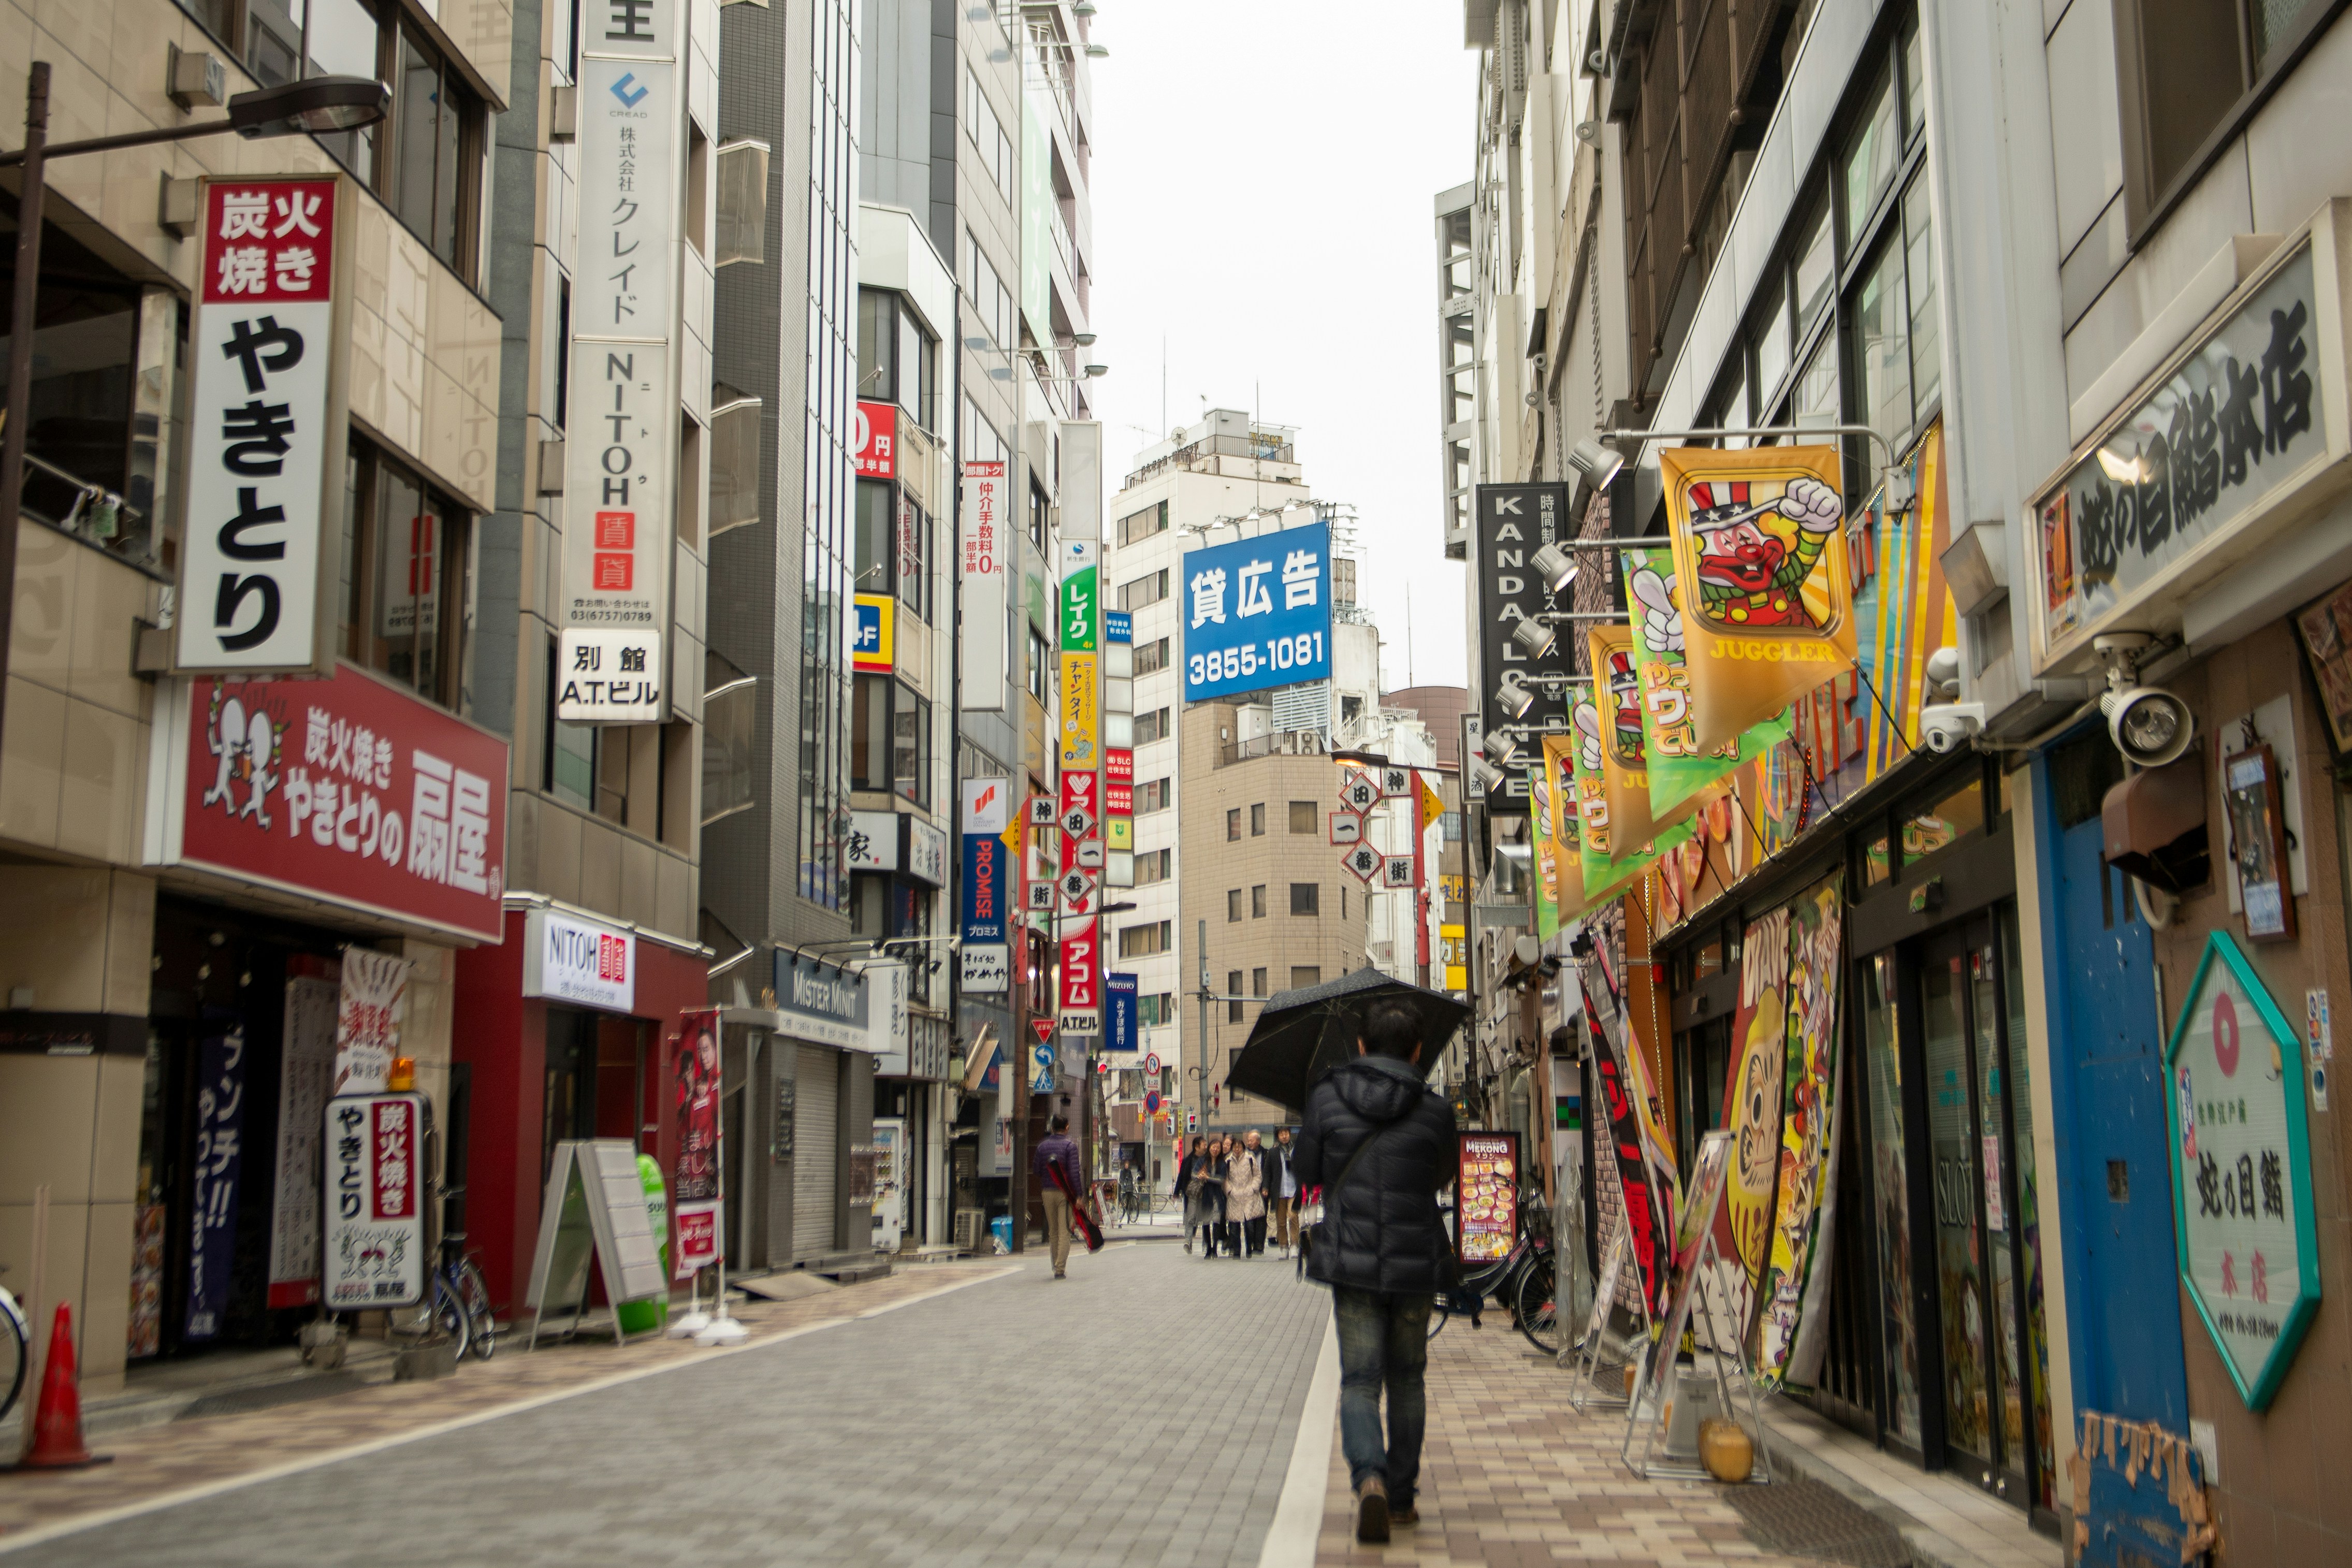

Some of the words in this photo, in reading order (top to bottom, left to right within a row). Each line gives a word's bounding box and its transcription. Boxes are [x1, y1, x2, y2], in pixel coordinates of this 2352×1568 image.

[609, 110, 647, 119] CREAD
[220, 190, 323, 241] 炭火
[608, 127, 640, 325] 株式会社クレイド
[217, 246, 317, 296] 焼き
[601, 353, 633, 506] NITOH
[213, 315, 304, 654] やきとり
[854, 458, 890, 473] 部半額
[966, 466, 1003, 476] 部屋トク!
[598, 515, 630, 588] 賃貸
[966, 534, 977, 573] 一部半額
[1495, 497, 1526, 622] KANDA
[571, 610, 652, 622] 03(6757)0789
[1068, 584, 1088, 639] レイク
[1189, 549, 1320, 630] 貸広告
[573, 646, 646, 672] 別館
[1189, 631, 1323, 686] 3855-1081
[1710, 640, 1837, 664] JUGGLER
[559, 680, 659, 705] A.T.ビル
[1500, 643, 1530, 797] LONGE
[304, 704, 394, 790] 炭火焼き
[283, 766, 404, 868] やきとりの
[407, 749, 491, 896] 扇屋
[976, 839, 993, 919] PROMISE
[549, 925, 597, 974] NITOH
[968, 925, 998, 937] プロミス
[1069, 943, 1091, 1005] アコム
[1108, 981, 1134, 990] MIZUHO
[1062, 1016, 1098, 1031] A.T.ビル
[1116, 1000, 1125, 1045] みずほ銀行
[337, 1106, 363, 1221] やきとり
[378, 1103, 409, 1216] 炭火焼き
[1466, 1140, 1507, 1154] MEKONG
[2220, 1246, 2269, 1305] 本店
